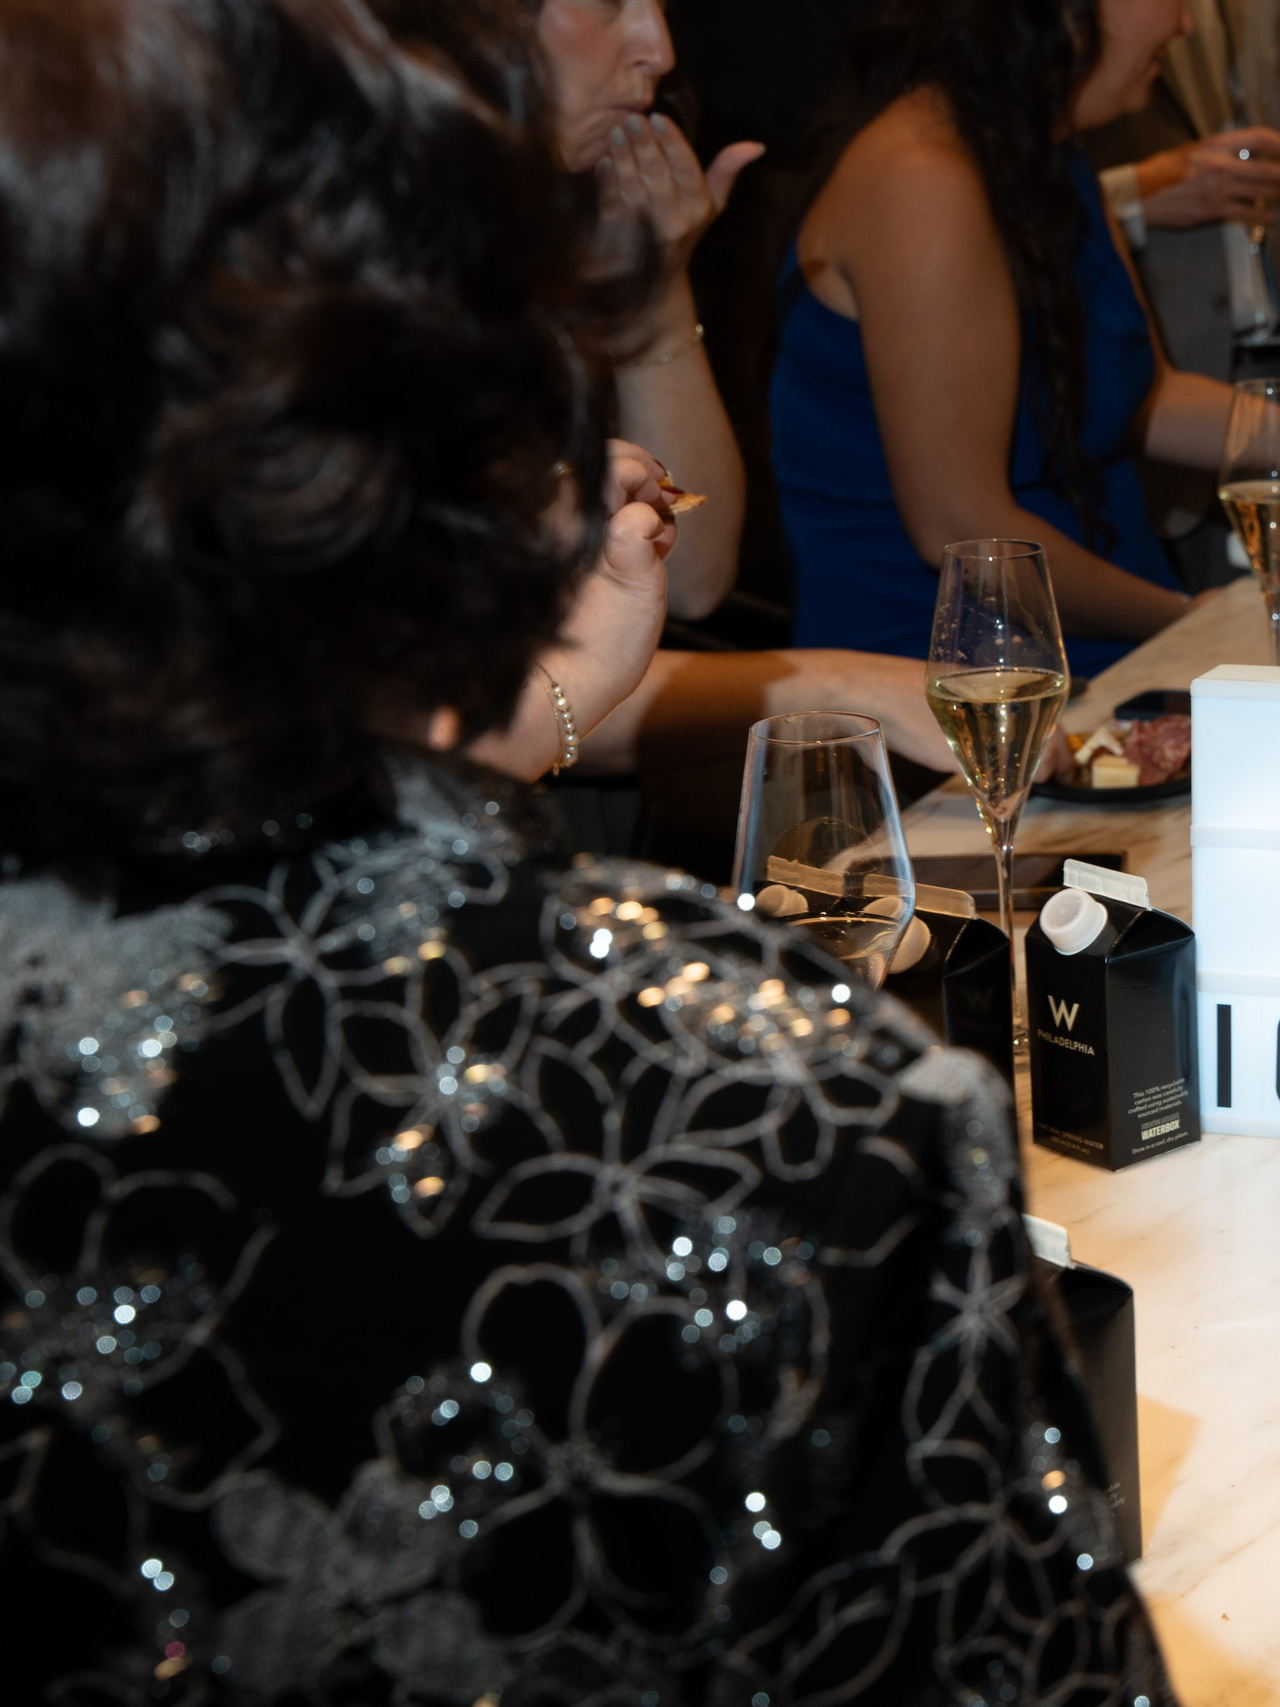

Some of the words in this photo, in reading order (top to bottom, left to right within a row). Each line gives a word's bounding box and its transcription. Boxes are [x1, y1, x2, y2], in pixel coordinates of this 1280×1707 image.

[1047, 994, 1080, 1032] W
[1037, 1028, 1096, 1056] PHILADELPHIA
[1134, 1096, 1152, 1106] carton
[1145, 1086, 1160, 1095] 100%
[1141, 1119, 1181, 1141] WATERBOX
